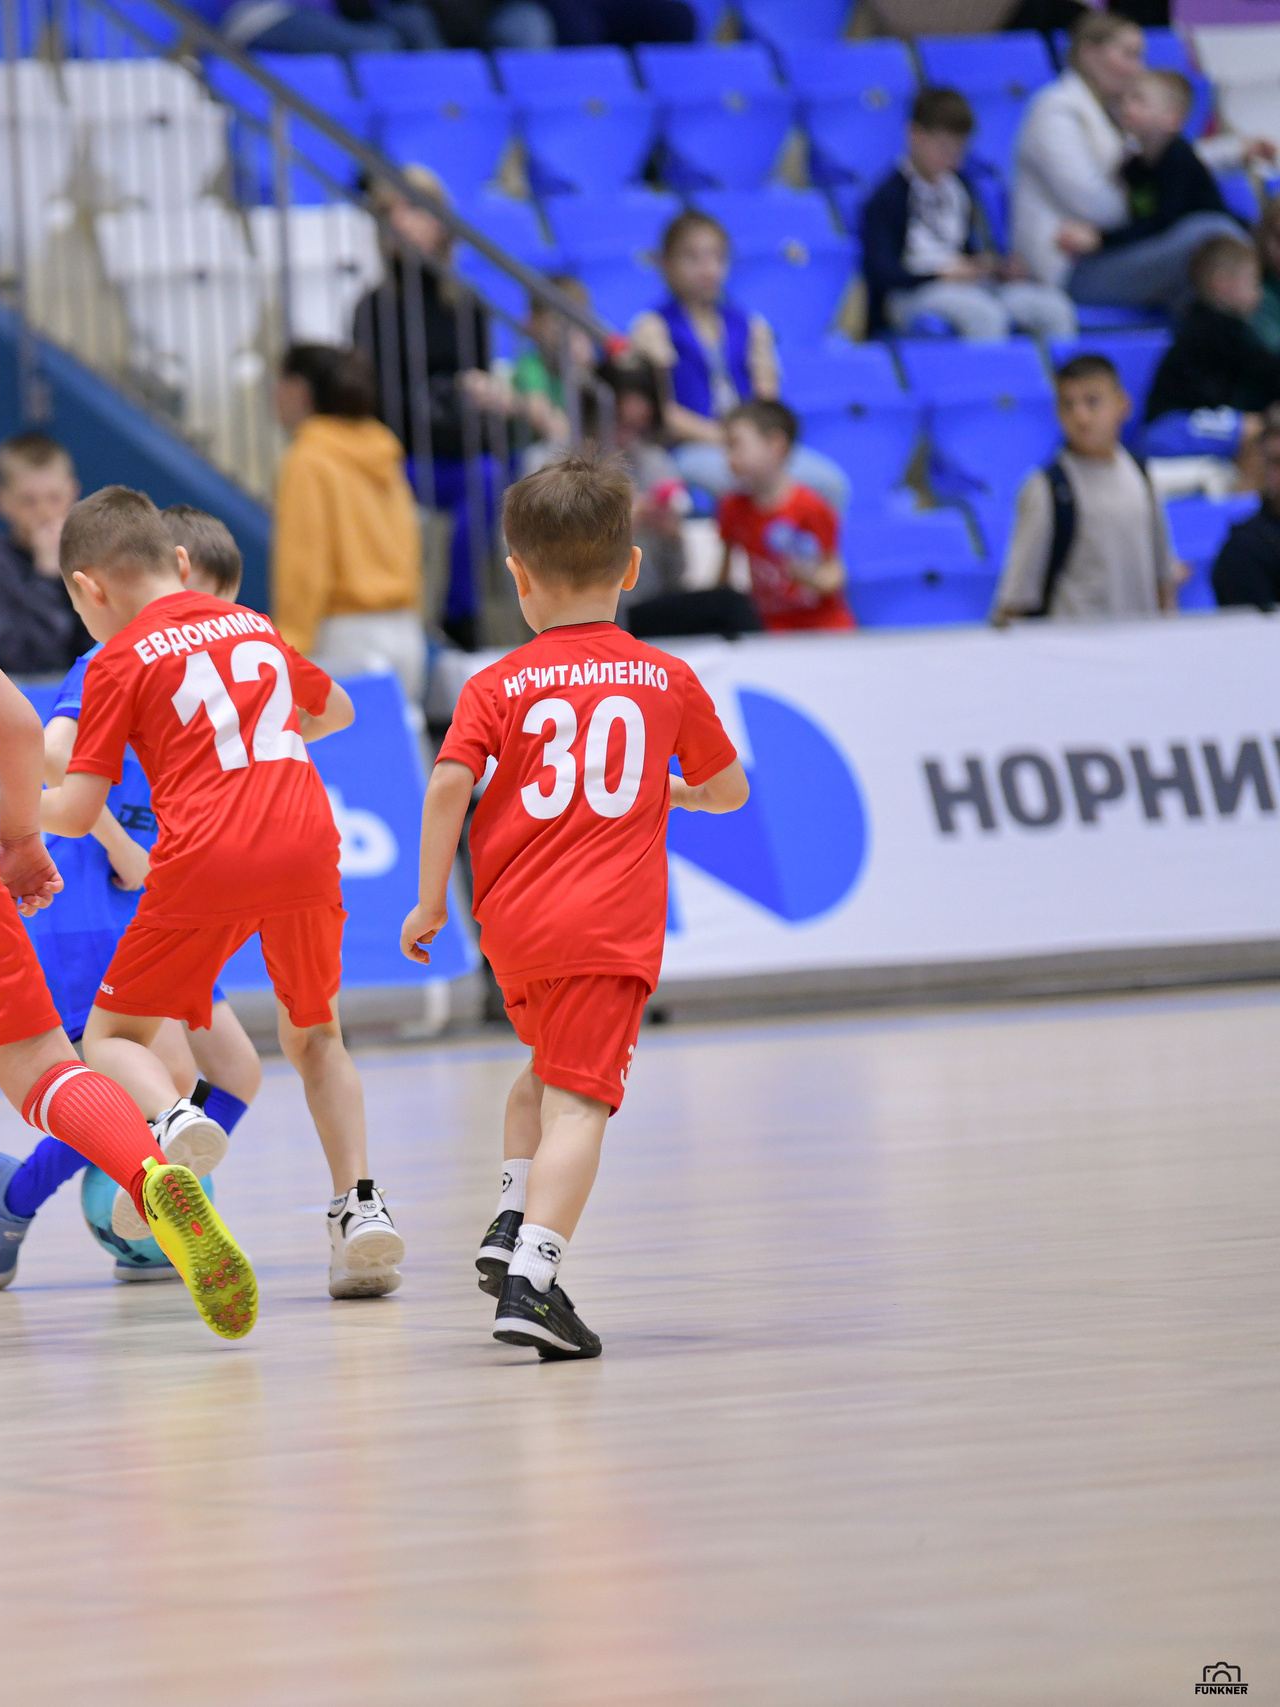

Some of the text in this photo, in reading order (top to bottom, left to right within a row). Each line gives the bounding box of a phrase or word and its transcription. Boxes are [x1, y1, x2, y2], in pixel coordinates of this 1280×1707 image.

[171, 641, 309, 771] 12
[504, 659, 668, 698] НЕЧИТАЙЛЕНКО
[521, 696, 645, 819] 30
[923, 738, 1280, 834] НОРНИ
